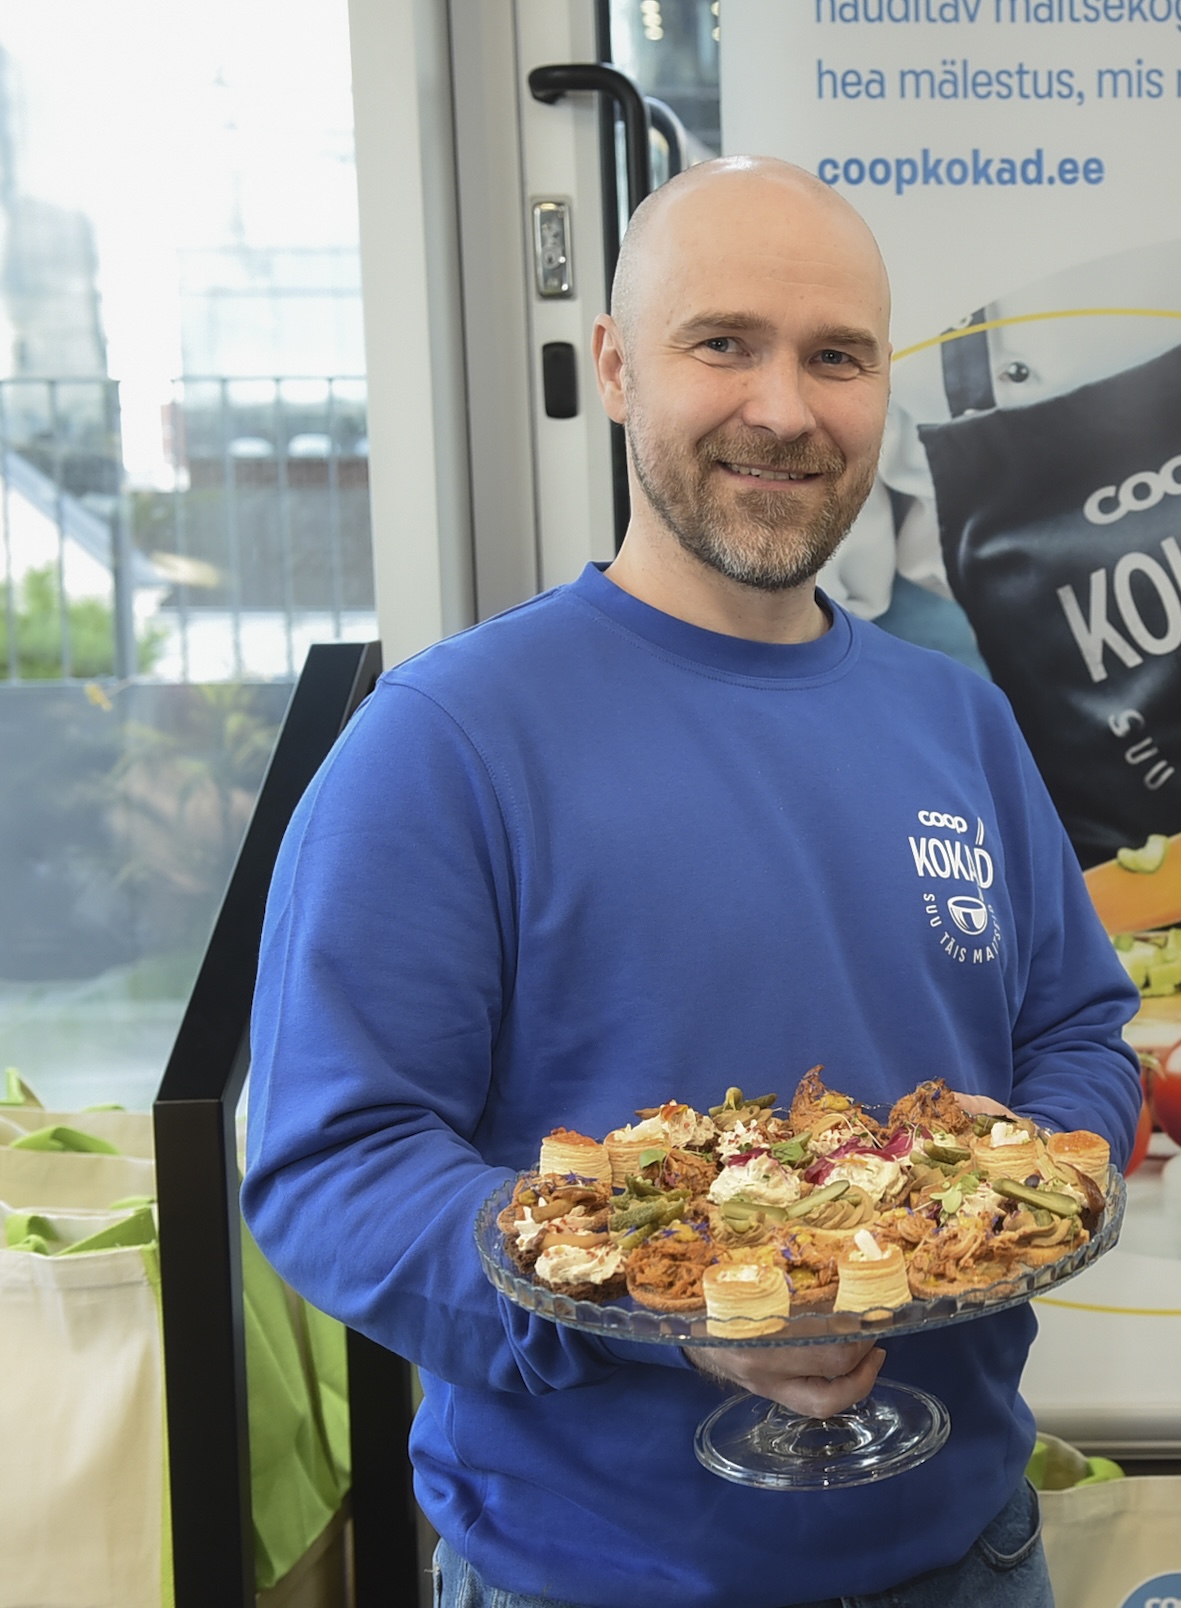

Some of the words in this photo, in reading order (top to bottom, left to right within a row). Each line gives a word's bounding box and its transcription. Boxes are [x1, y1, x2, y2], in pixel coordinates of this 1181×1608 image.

[817, 58, 886, 99] hea
[899, 58, 1085, 106] mälestus,
[1097, 58, 1163, 99] mis
[817, 148, 1105, 195] coopkokad.ee
[1108, 708, 1175, 790] SUU
[918, 810, 968, 833] coop
[908, 836, 994, 889] KOKAD
[923, 893, 942, 928] SUU
[940, 931, 967, 963] TÄIS
